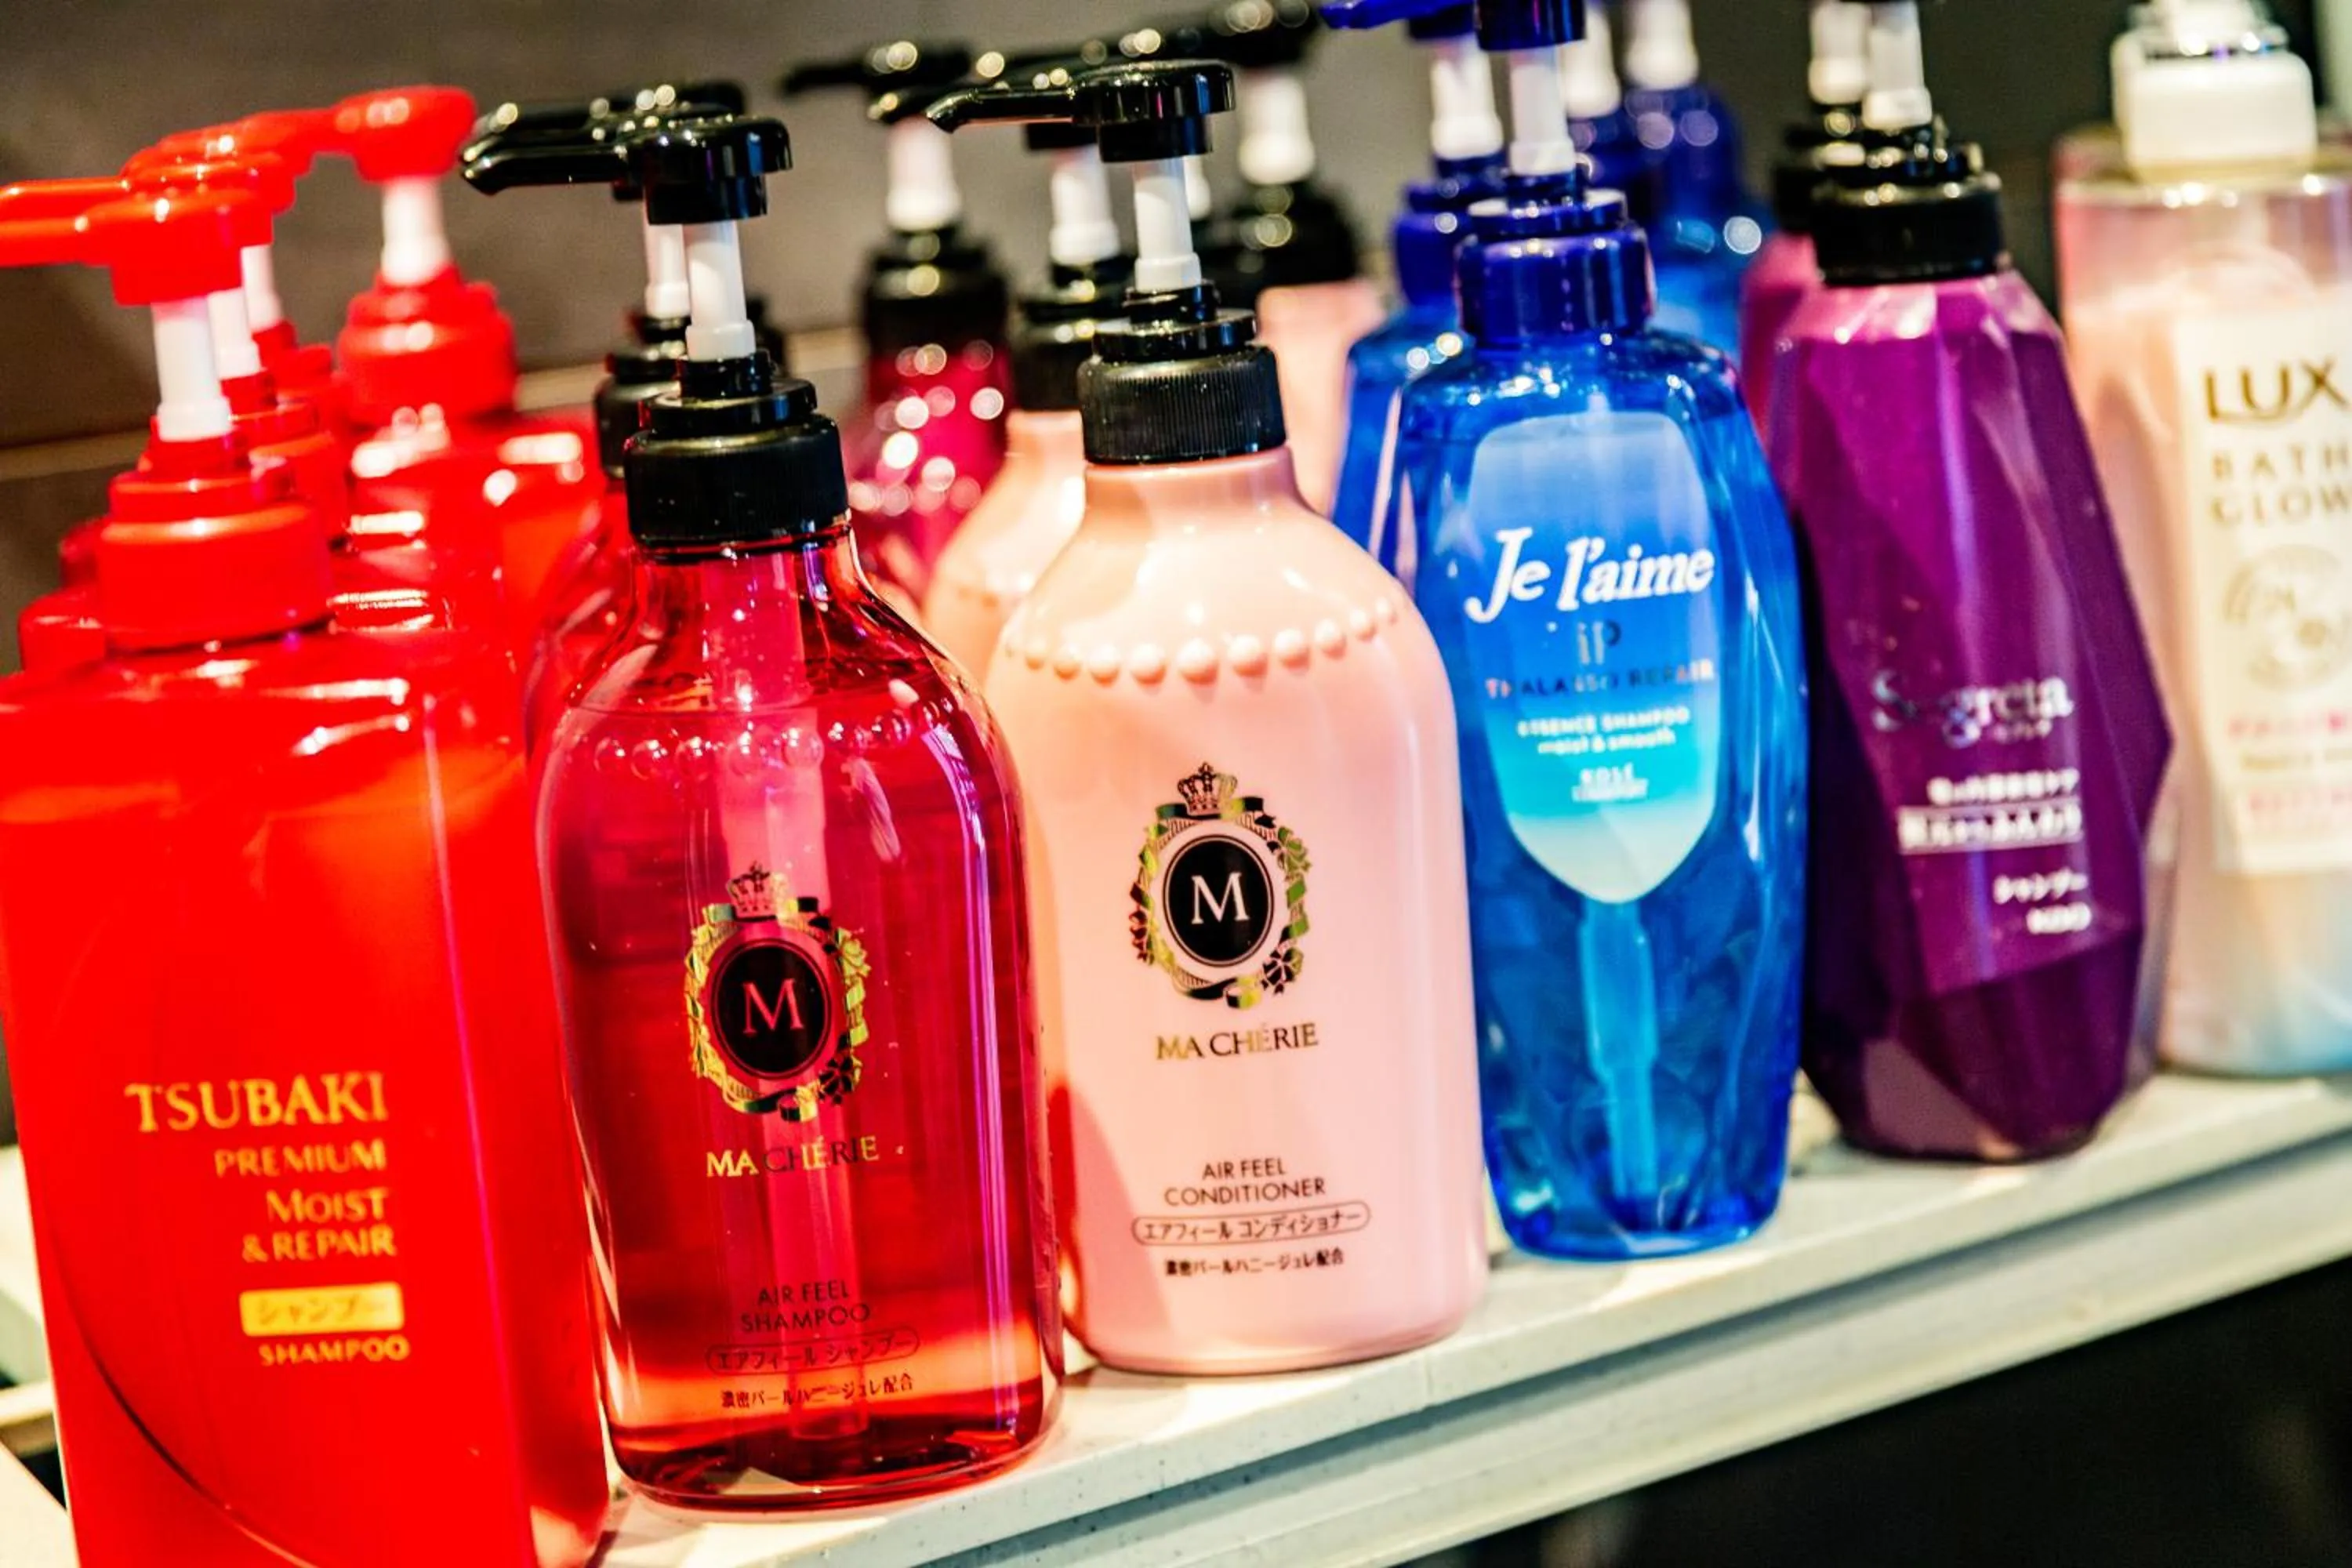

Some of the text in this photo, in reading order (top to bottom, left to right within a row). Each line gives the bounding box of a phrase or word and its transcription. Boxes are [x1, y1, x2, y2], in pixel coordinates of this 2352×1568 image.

[2204, 358, 2350, 426] LUX
[1463, 526, 1551, 623] Je
[1191, 872, 1249, 924] M
[742, 978, 804, 1034] M
[1156, 1035, 1205, 1060] MA
[124, 1071, 389, 1132] TSUBAKI
[214, 1138, 387, 1178] PREMIUM
[706, 1150, 758, 1177] MA
[1202, 1158, 1286, 1180] AIR FEEL
[1164, 1177, 1326, 1207] CONDITIONER
[272, 1224, 397, 1261] REPAIR
[757, 1279, 849, 1306] AIR FEEL
[741, 1304, 870, 1332] SHAMPOO
[259, 1334, 410, 1367] SHAMPOO
